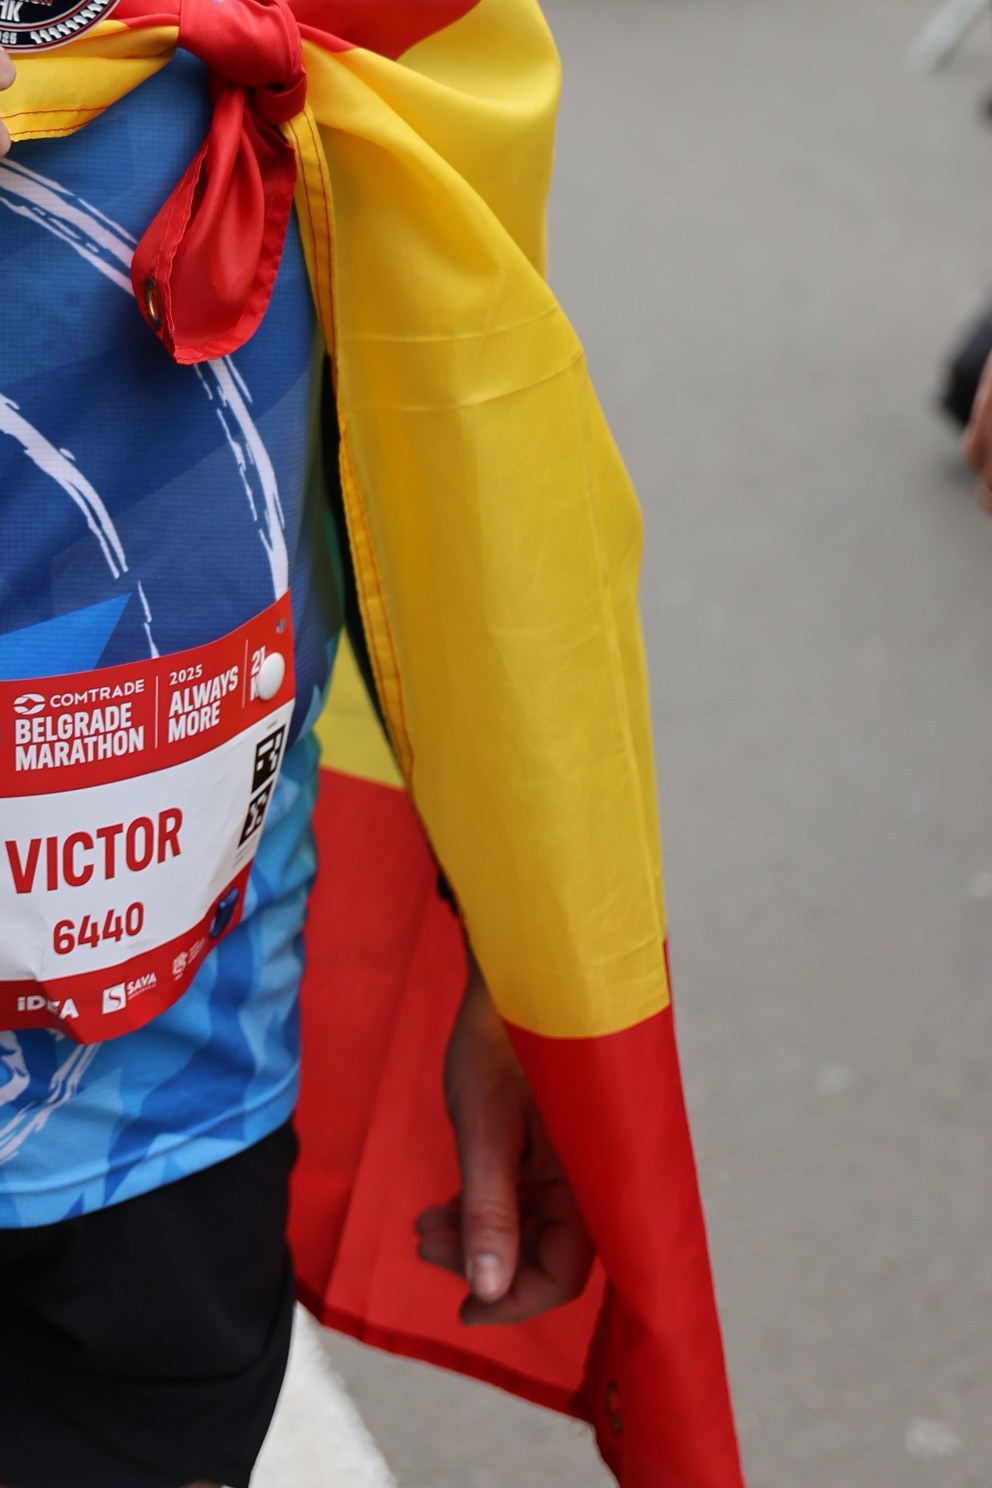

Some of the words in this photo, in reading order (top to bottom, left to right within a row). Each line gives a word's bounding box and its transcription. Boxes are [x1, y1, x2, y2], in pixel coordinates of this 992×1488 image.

[49, 678, 145, 708] COMTRADE
[168, 665, 239, 718] ALWAYS
[169, 663, 203, 686] 2025
[15, 701, 132, 745] BELGRADE
[168, 699, 221, 744] MORE
[15, 725, 145, 772] MARATHON
[4, 806, 184, 895] VICTOR
[53, 900, 145, 955] 6440
[127, 971, 158, 996] SAVA
